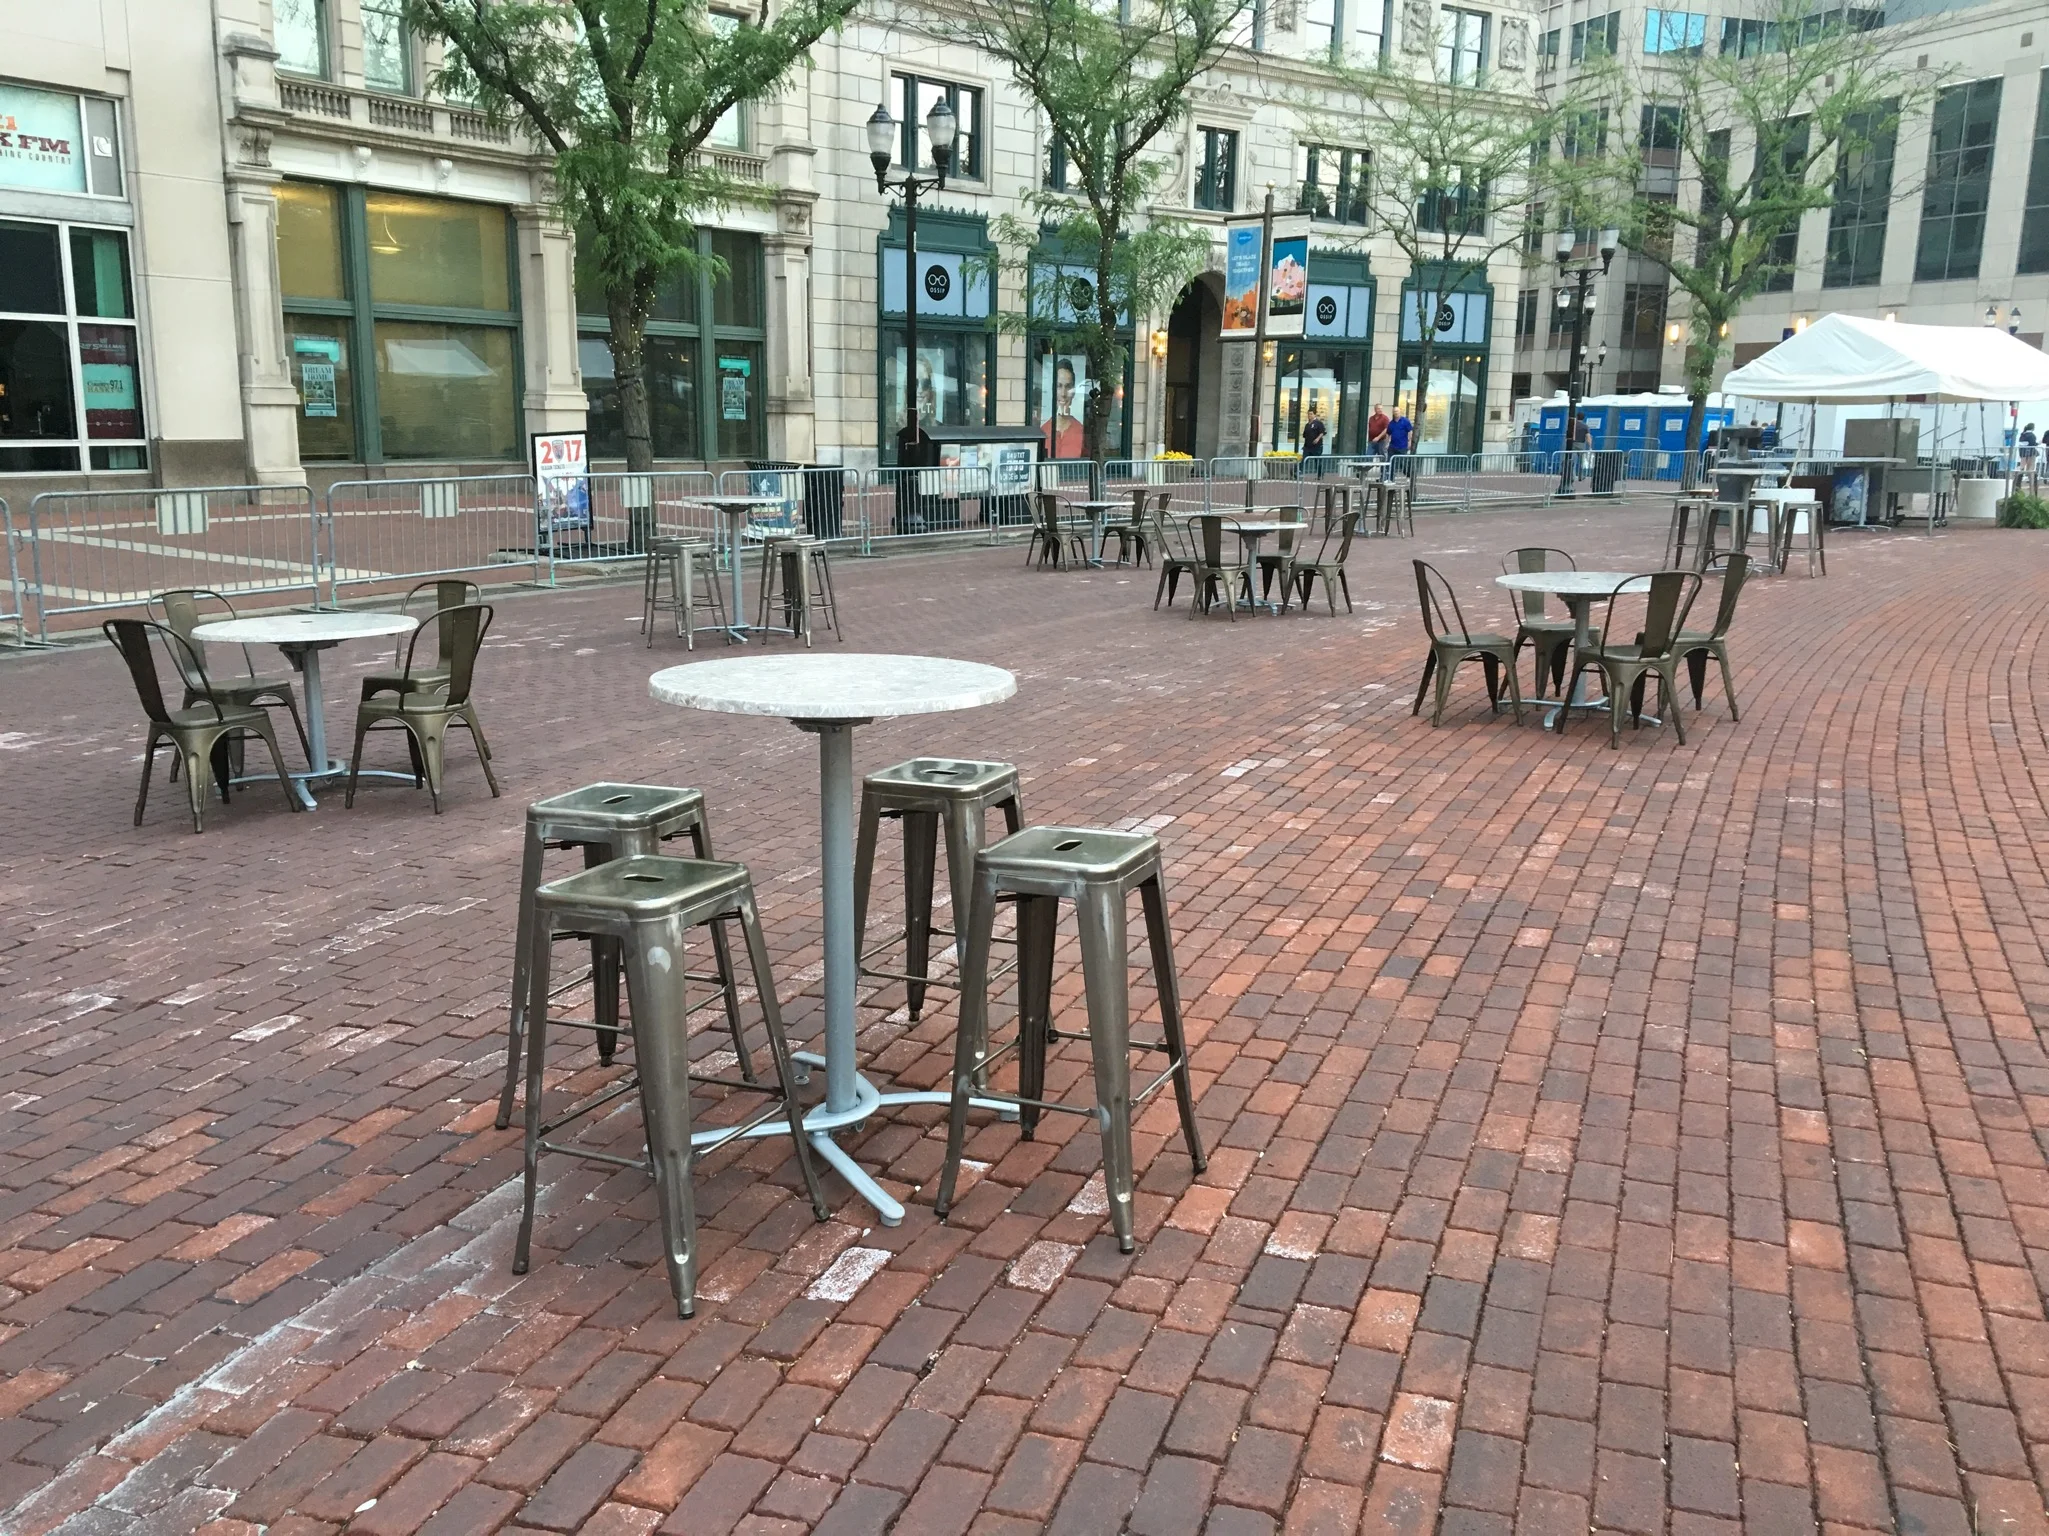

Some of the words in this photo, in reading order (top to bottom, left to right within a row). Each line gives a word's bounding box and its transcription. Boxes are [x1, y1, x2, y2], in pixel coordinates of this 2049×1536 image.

[18, 134, 70, 154] FM
[29, 152, 71, 165] COUNTRY
[110, 379, 123, 390] 97.1
